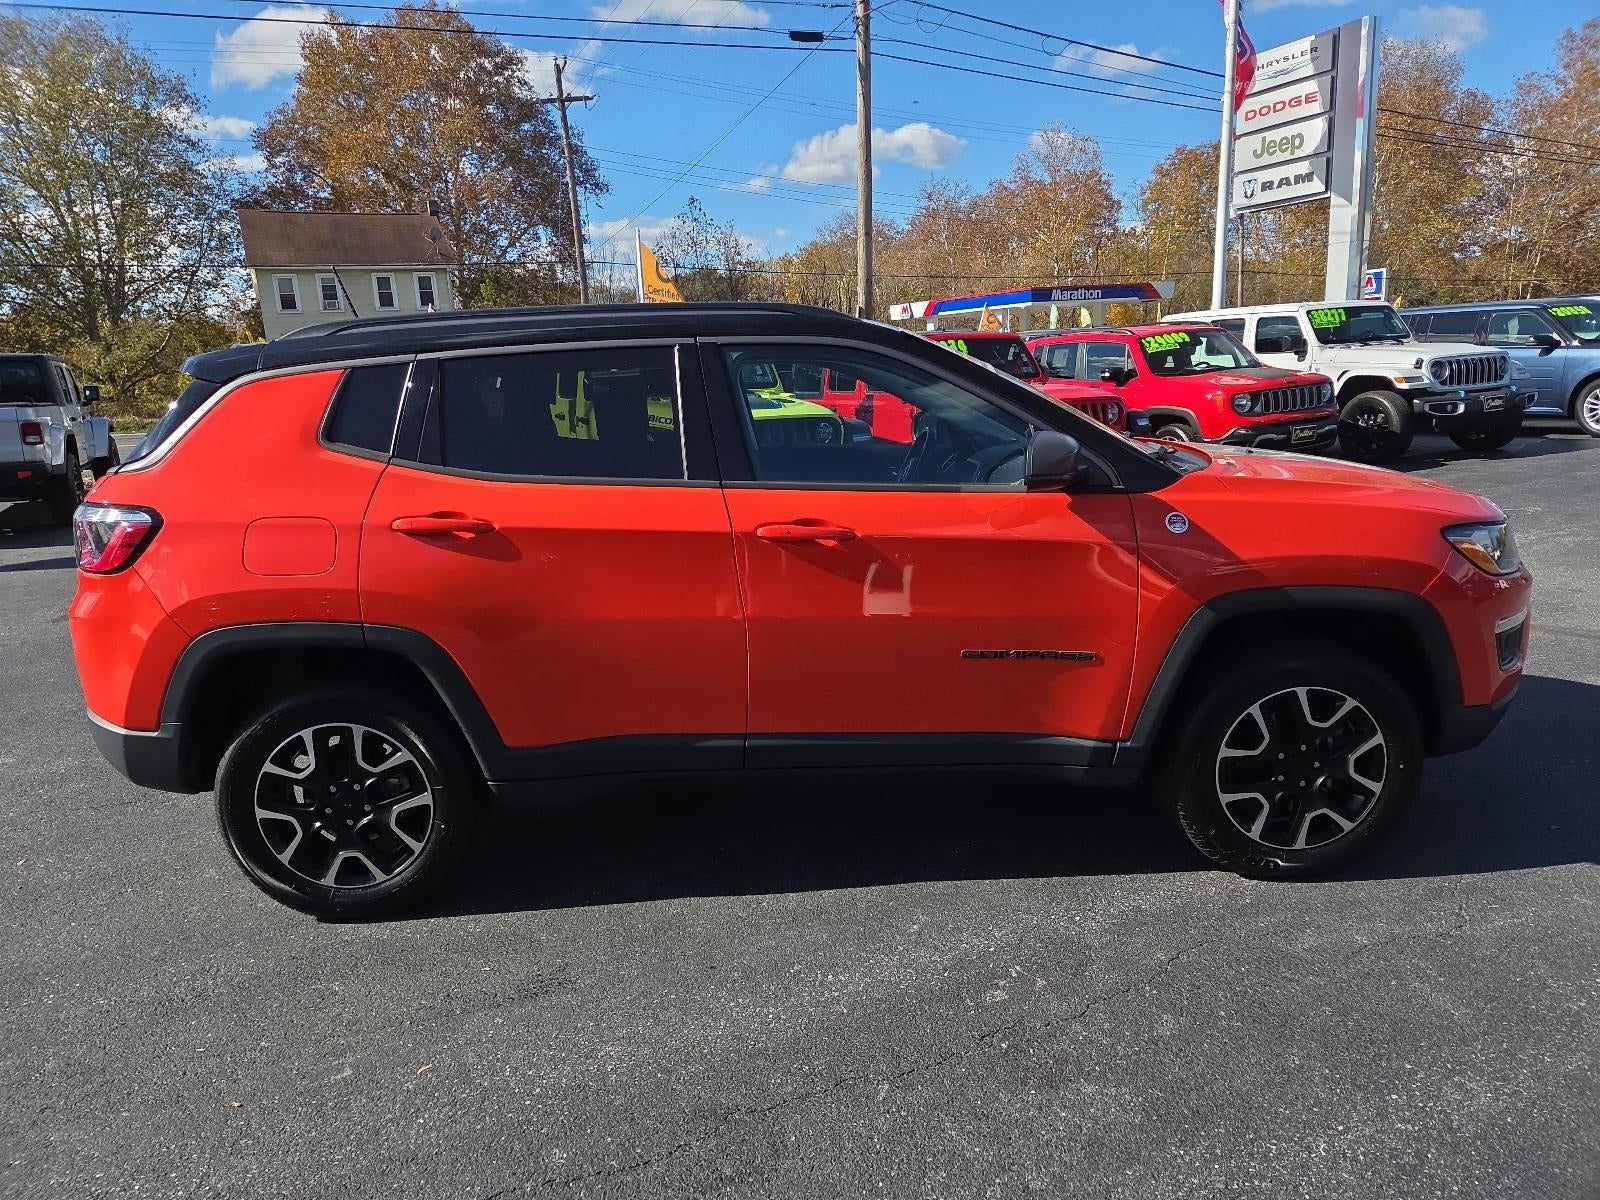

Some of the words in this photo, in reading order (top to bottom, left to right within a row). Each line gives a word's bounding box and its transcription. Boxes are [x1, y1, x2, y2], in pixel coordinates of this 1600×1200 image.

[1256, 46, 1319, 71] HRYSLER
[1244, 91, 1319, 122] DODGE
[1252, 132, 1305, 159] Jeep
[1260, 171, 1315, 193] RAM
[647, 284, 680, 301] Certified
[1051, 288, 1102, 301] Marathon
[960, 649, 1096, 661] COMPASS
